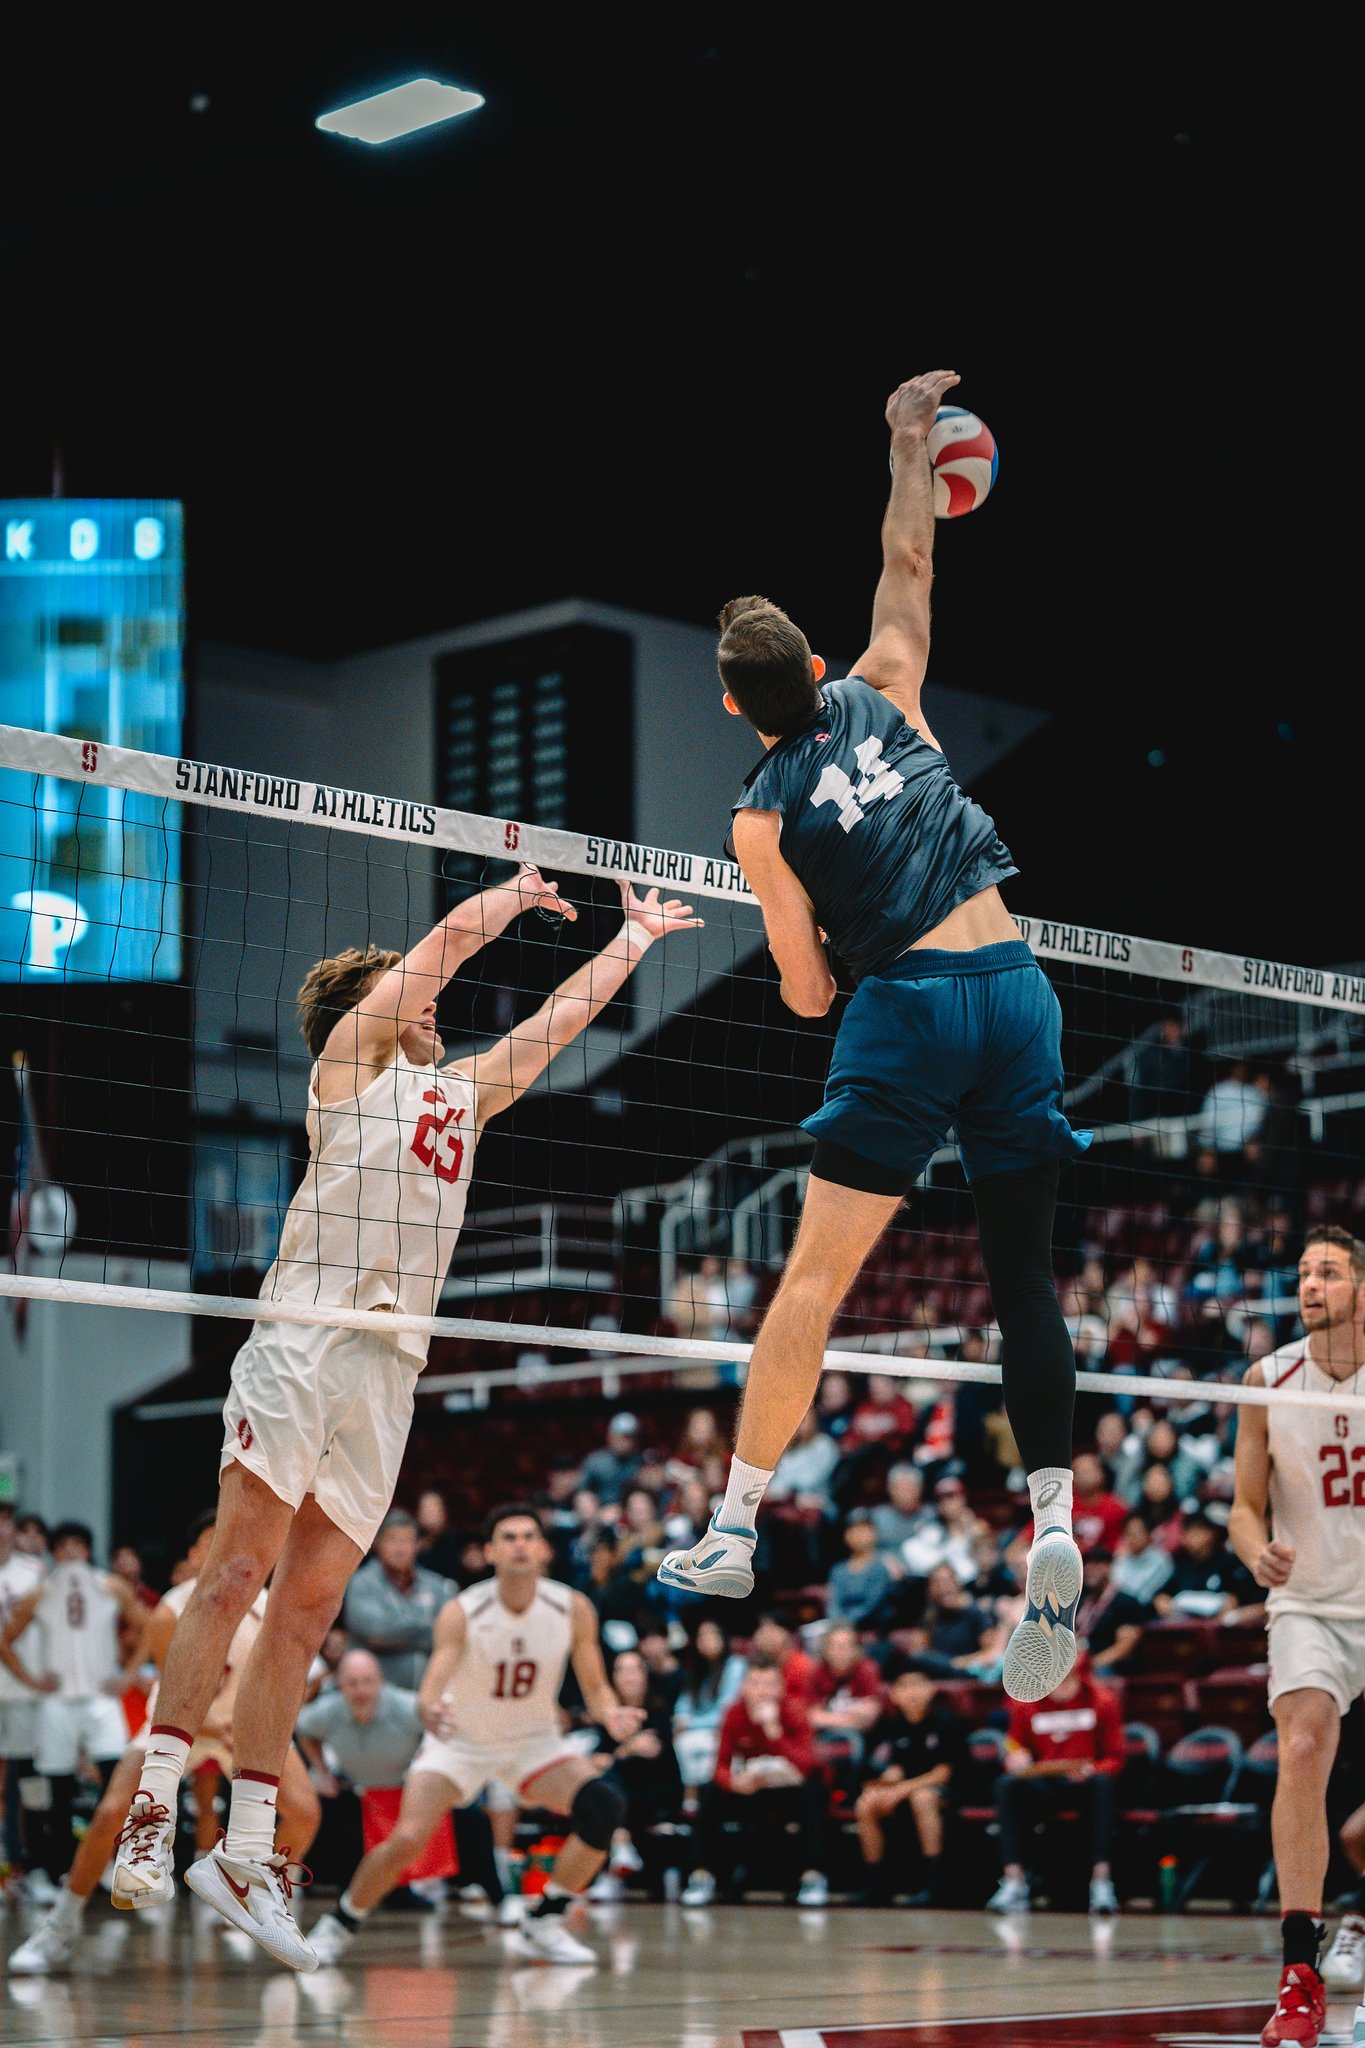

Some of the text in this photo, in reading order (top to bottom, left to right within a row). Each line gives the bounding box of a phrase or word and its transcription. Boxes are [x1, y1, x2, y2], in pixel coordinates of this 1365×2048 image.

[6, 518, 34, 560] K
[176, 759, 437, 835] STANFORD ATHLETICS
[810, 735, 905, 834] 14
[586, 836, 693, 883] STANFORD
[11, 890, 89, 974] P
[1039, 922, 1131, 963] ATHLETICS
[1243, 959, 1325, 997] STANFORD
[493, 1661, 537, 1700] 18
